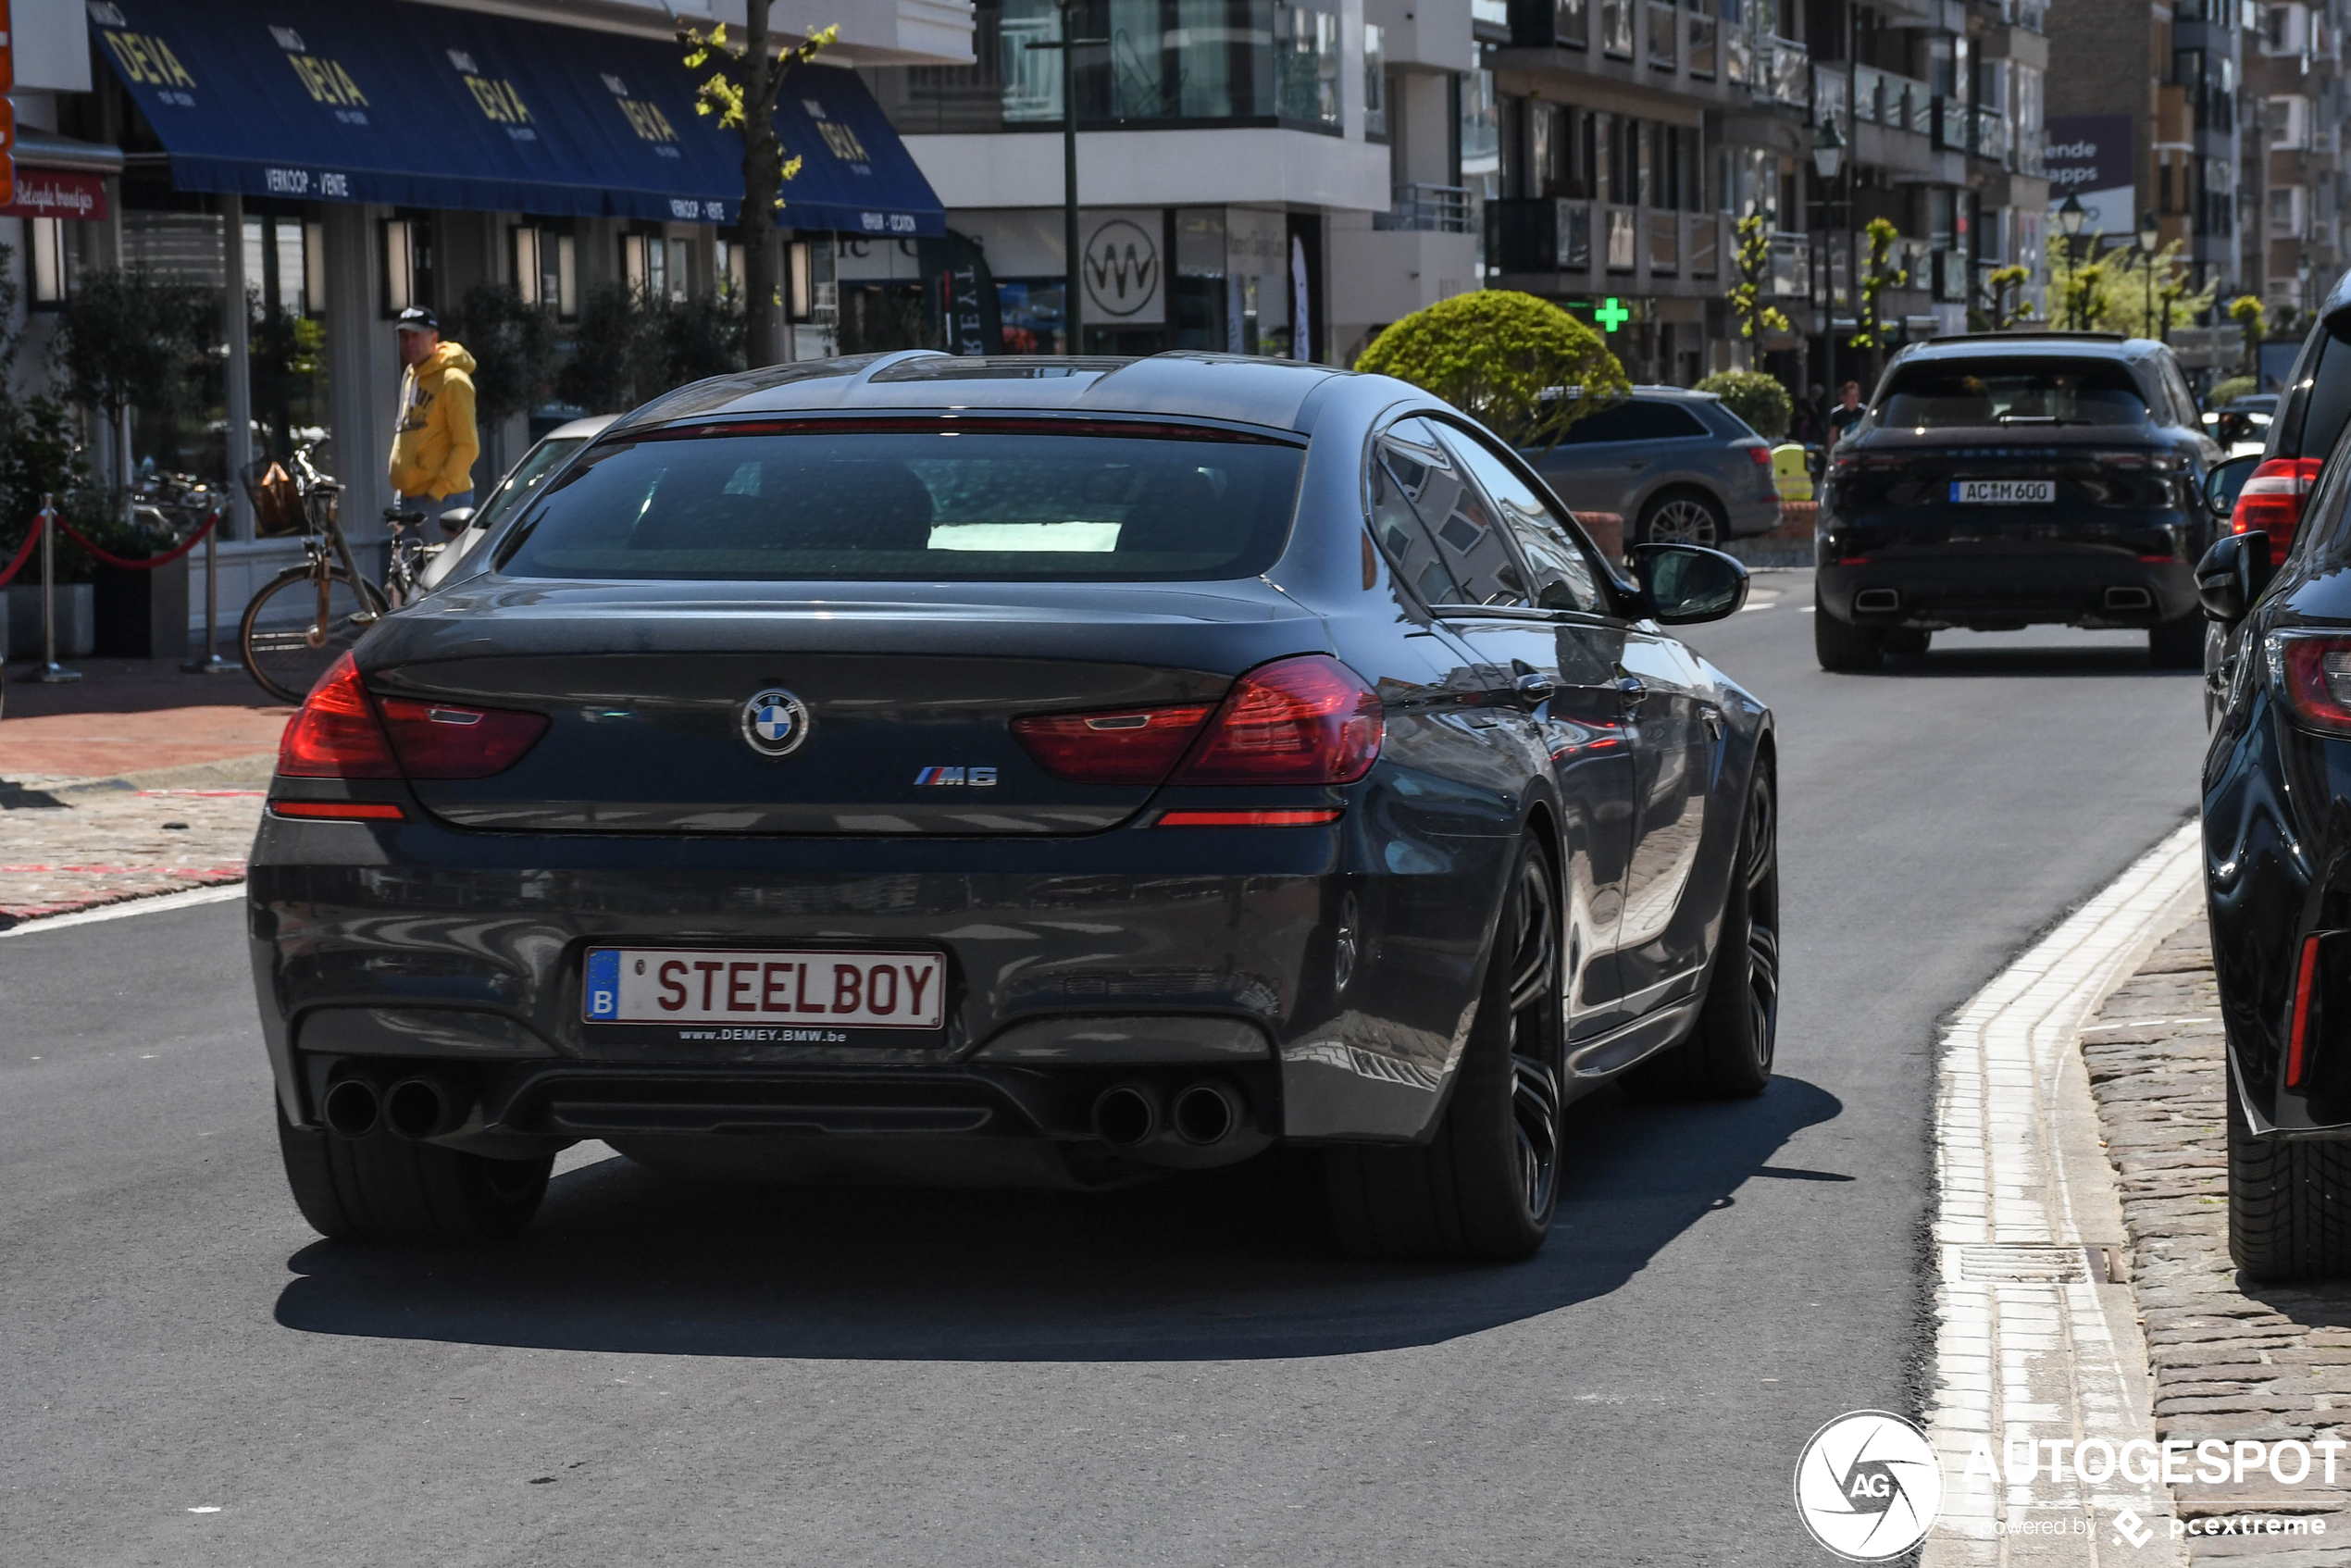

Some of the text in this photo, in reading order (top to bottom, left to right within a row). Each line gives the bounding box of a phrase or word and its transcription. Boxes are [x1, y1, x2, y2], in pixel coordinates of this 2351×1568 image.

[103, 30, 197, 89] DEVA
[287, 54, 369, 106] DEVA
[264, 168, 309, 193] VERKOOP
[593, 990, 613, 1014] B
[657, 960, 933, 1016] STEELBOY
[679, 1029, 847, 1043] www.DEMEY.BMW.be
